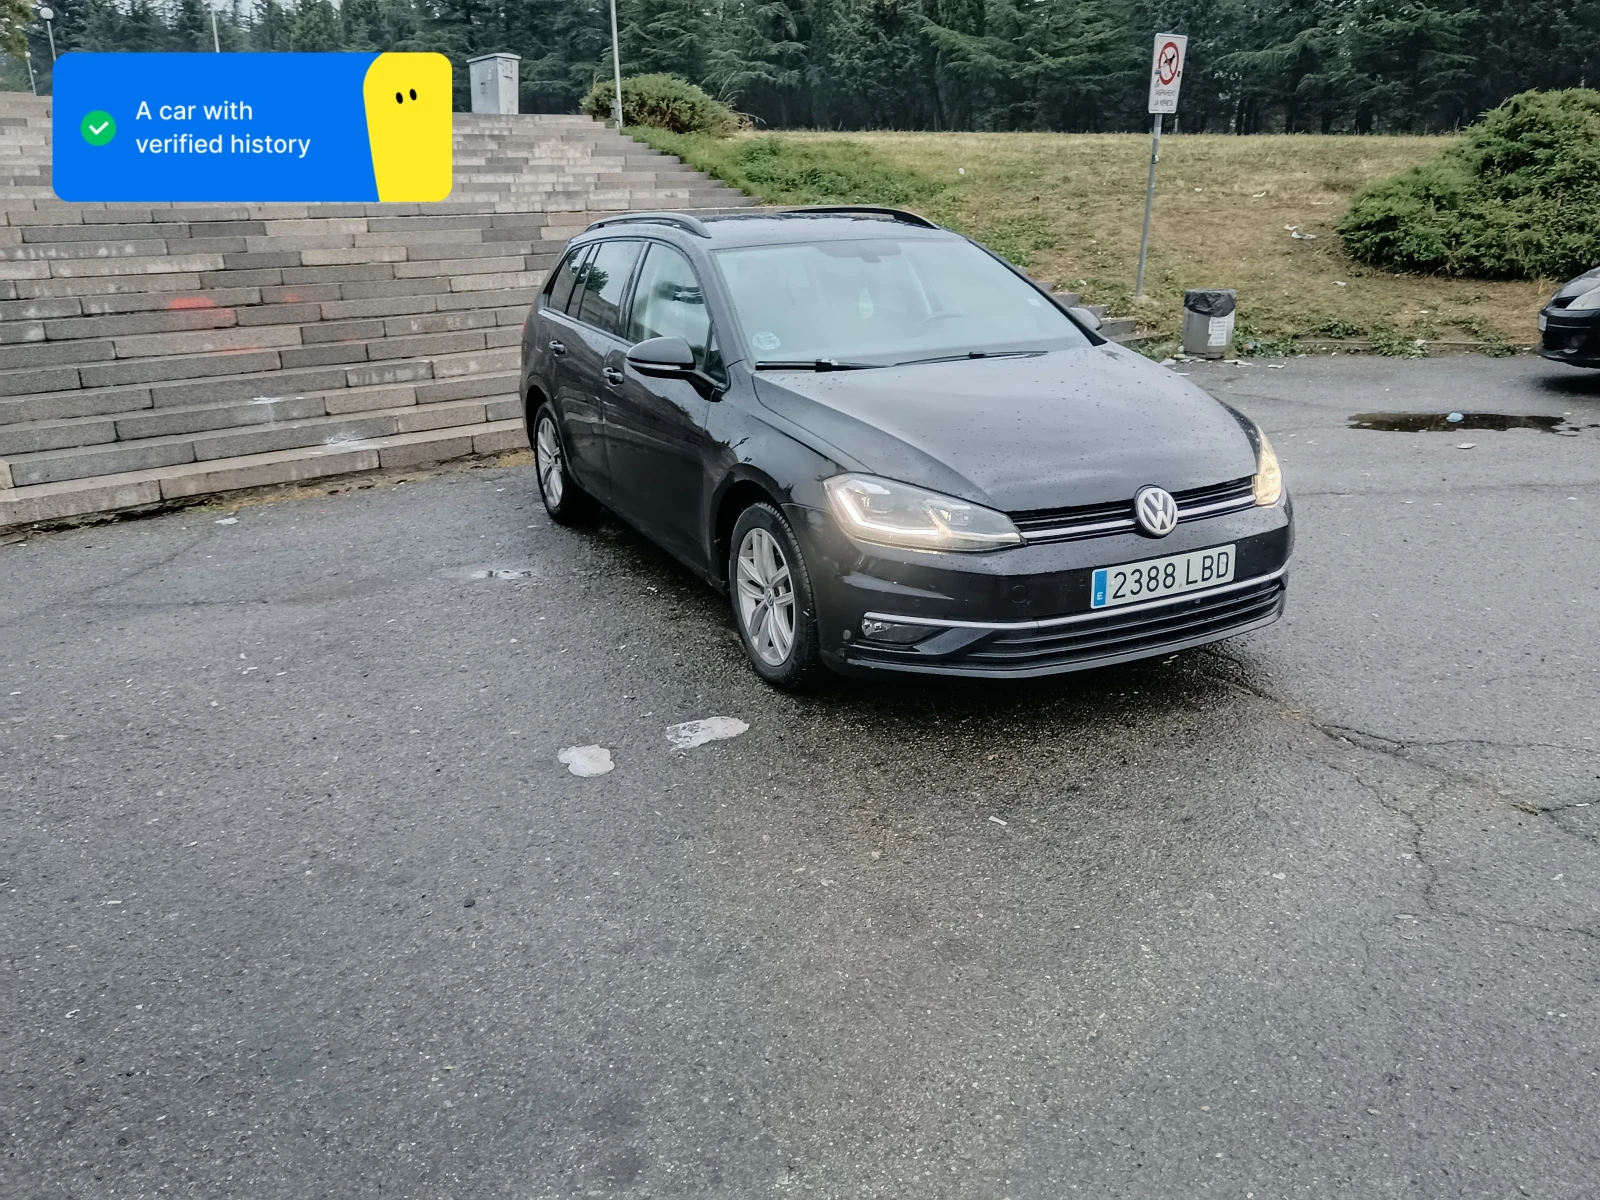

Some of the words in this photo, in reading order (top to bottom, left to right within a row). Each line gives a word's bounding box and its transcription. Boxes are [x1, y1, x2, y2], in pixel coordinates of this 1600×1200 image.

[1138, 488, 1177, 534] VW
[1096, 591, 1104, 601] E
[1112, 562, 1176, 600] 2388
[1185, 551, 1230, 586] LBD
